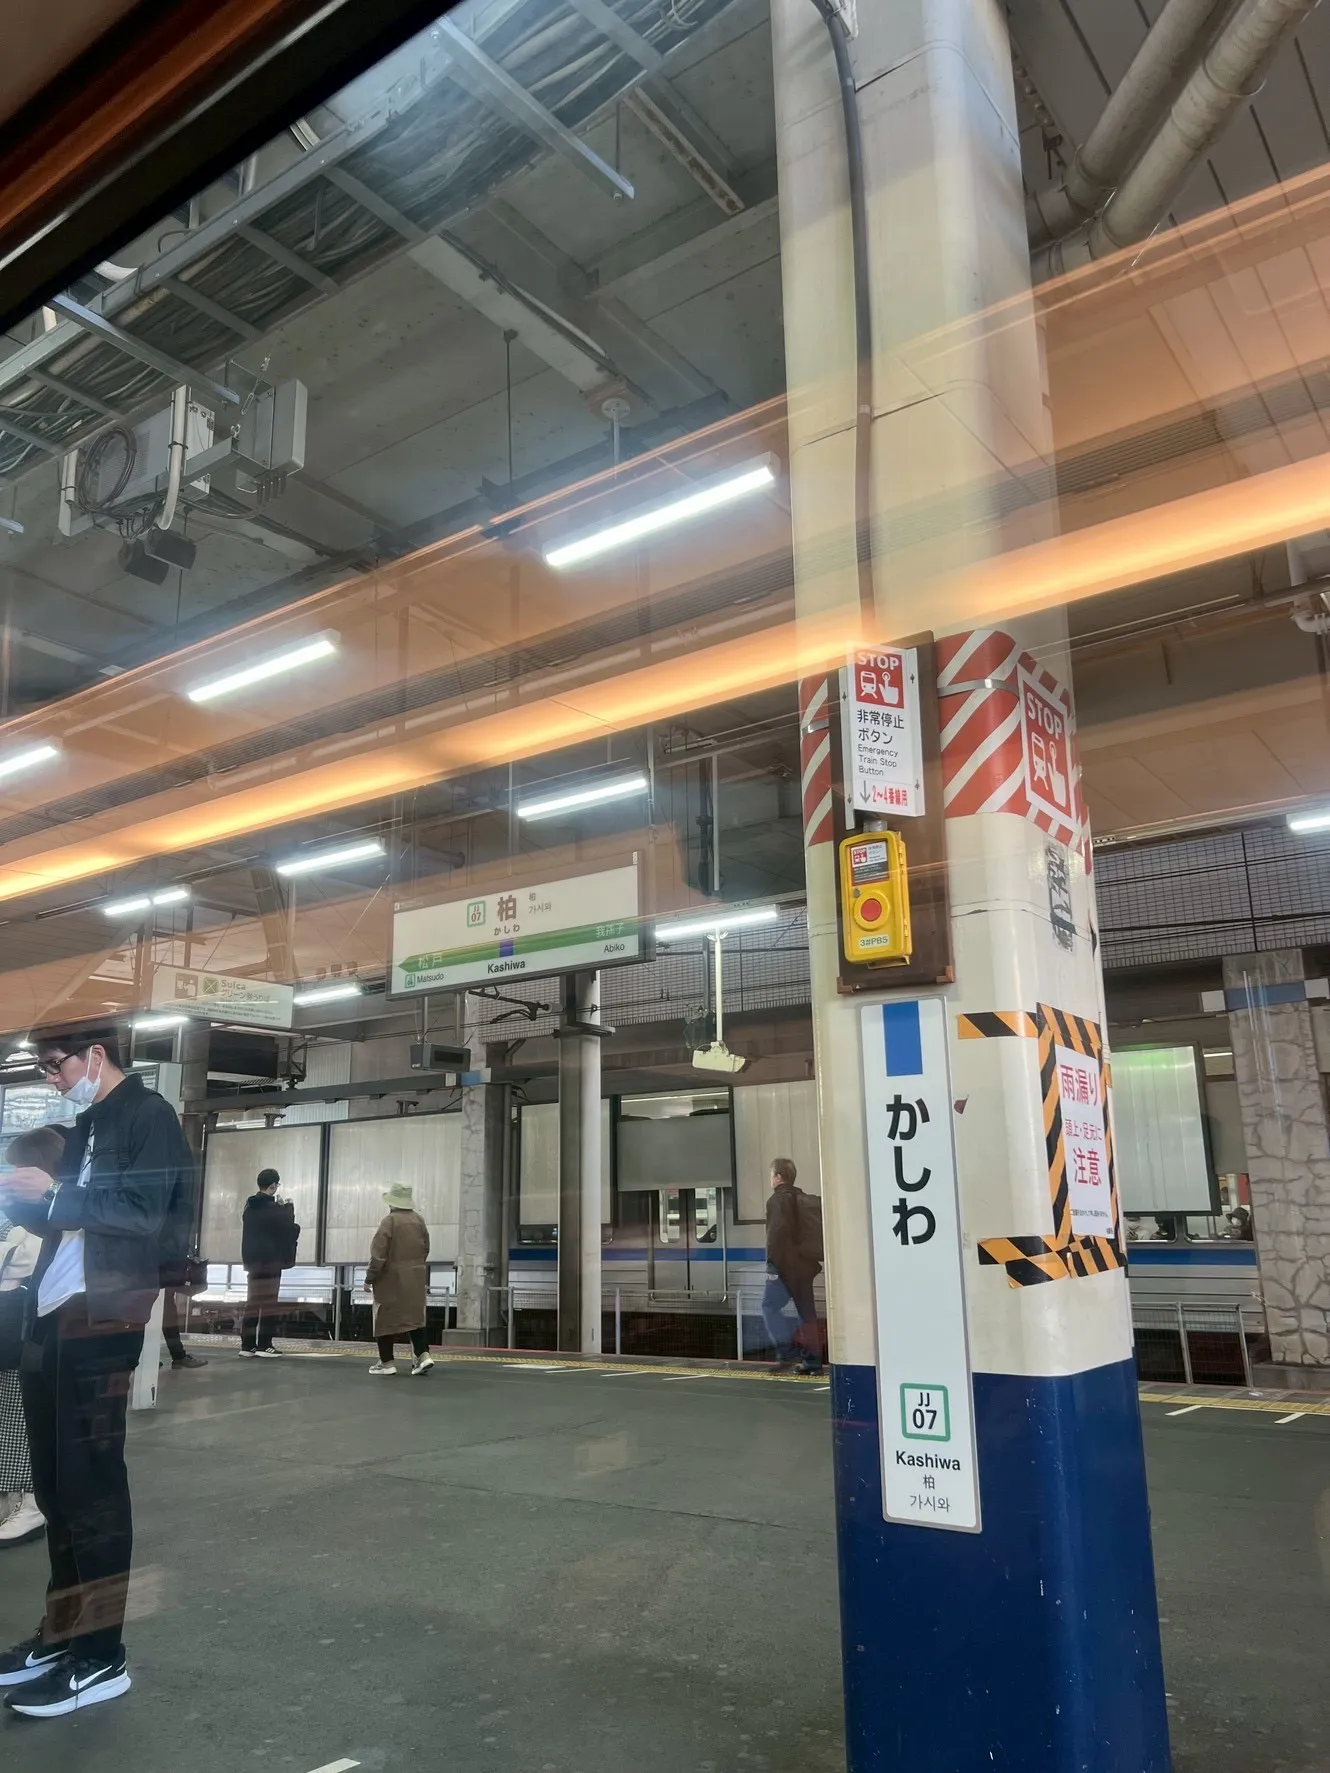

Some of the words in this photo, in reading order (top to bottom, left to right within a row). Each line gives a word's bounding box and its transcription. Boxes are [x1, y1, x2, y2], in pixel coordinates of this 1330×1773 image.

[858, 652, 899, 670] STOP
[857, 709, 905, 730] 非常停止
[1026, 692, 1063, 740] STOP
[858, 727, 893, 744] ボタン
[858, 743, 899, 758] Emergency
[859, 754, 877, 765] Train
[880, 757, 897, 768] Stop
[859, 765, 884, 776] Button
[497, 894, 517, 922] 柏
[528, 902, 551, 914] 가시와
[471, 911, 481, 922] 07
[494, 923, 520, 936] かしわ
[603, 943, 625, 953] Abiko
[418, 953, 442, 969] 松戸
[487, 960, 526, 974] Kashiwa
[220, 979, 246, 990] Suica
[416, 973, 445, 984] Matsudo
[1060, 1064, 1098, 1106] 雨漏り
[886, 1094, 936, 1245] かしわ
[1073, 1146, 1102, 1186] 注意
[917, 1392, 931, 1407] JJ
[912, 1408, 938, 1429] 07
[895, 1450, 961, 1471] Kashiwa
[922, 1474, 936, 1490] 柏
[910, 1494, 950, 1513] 가시와
